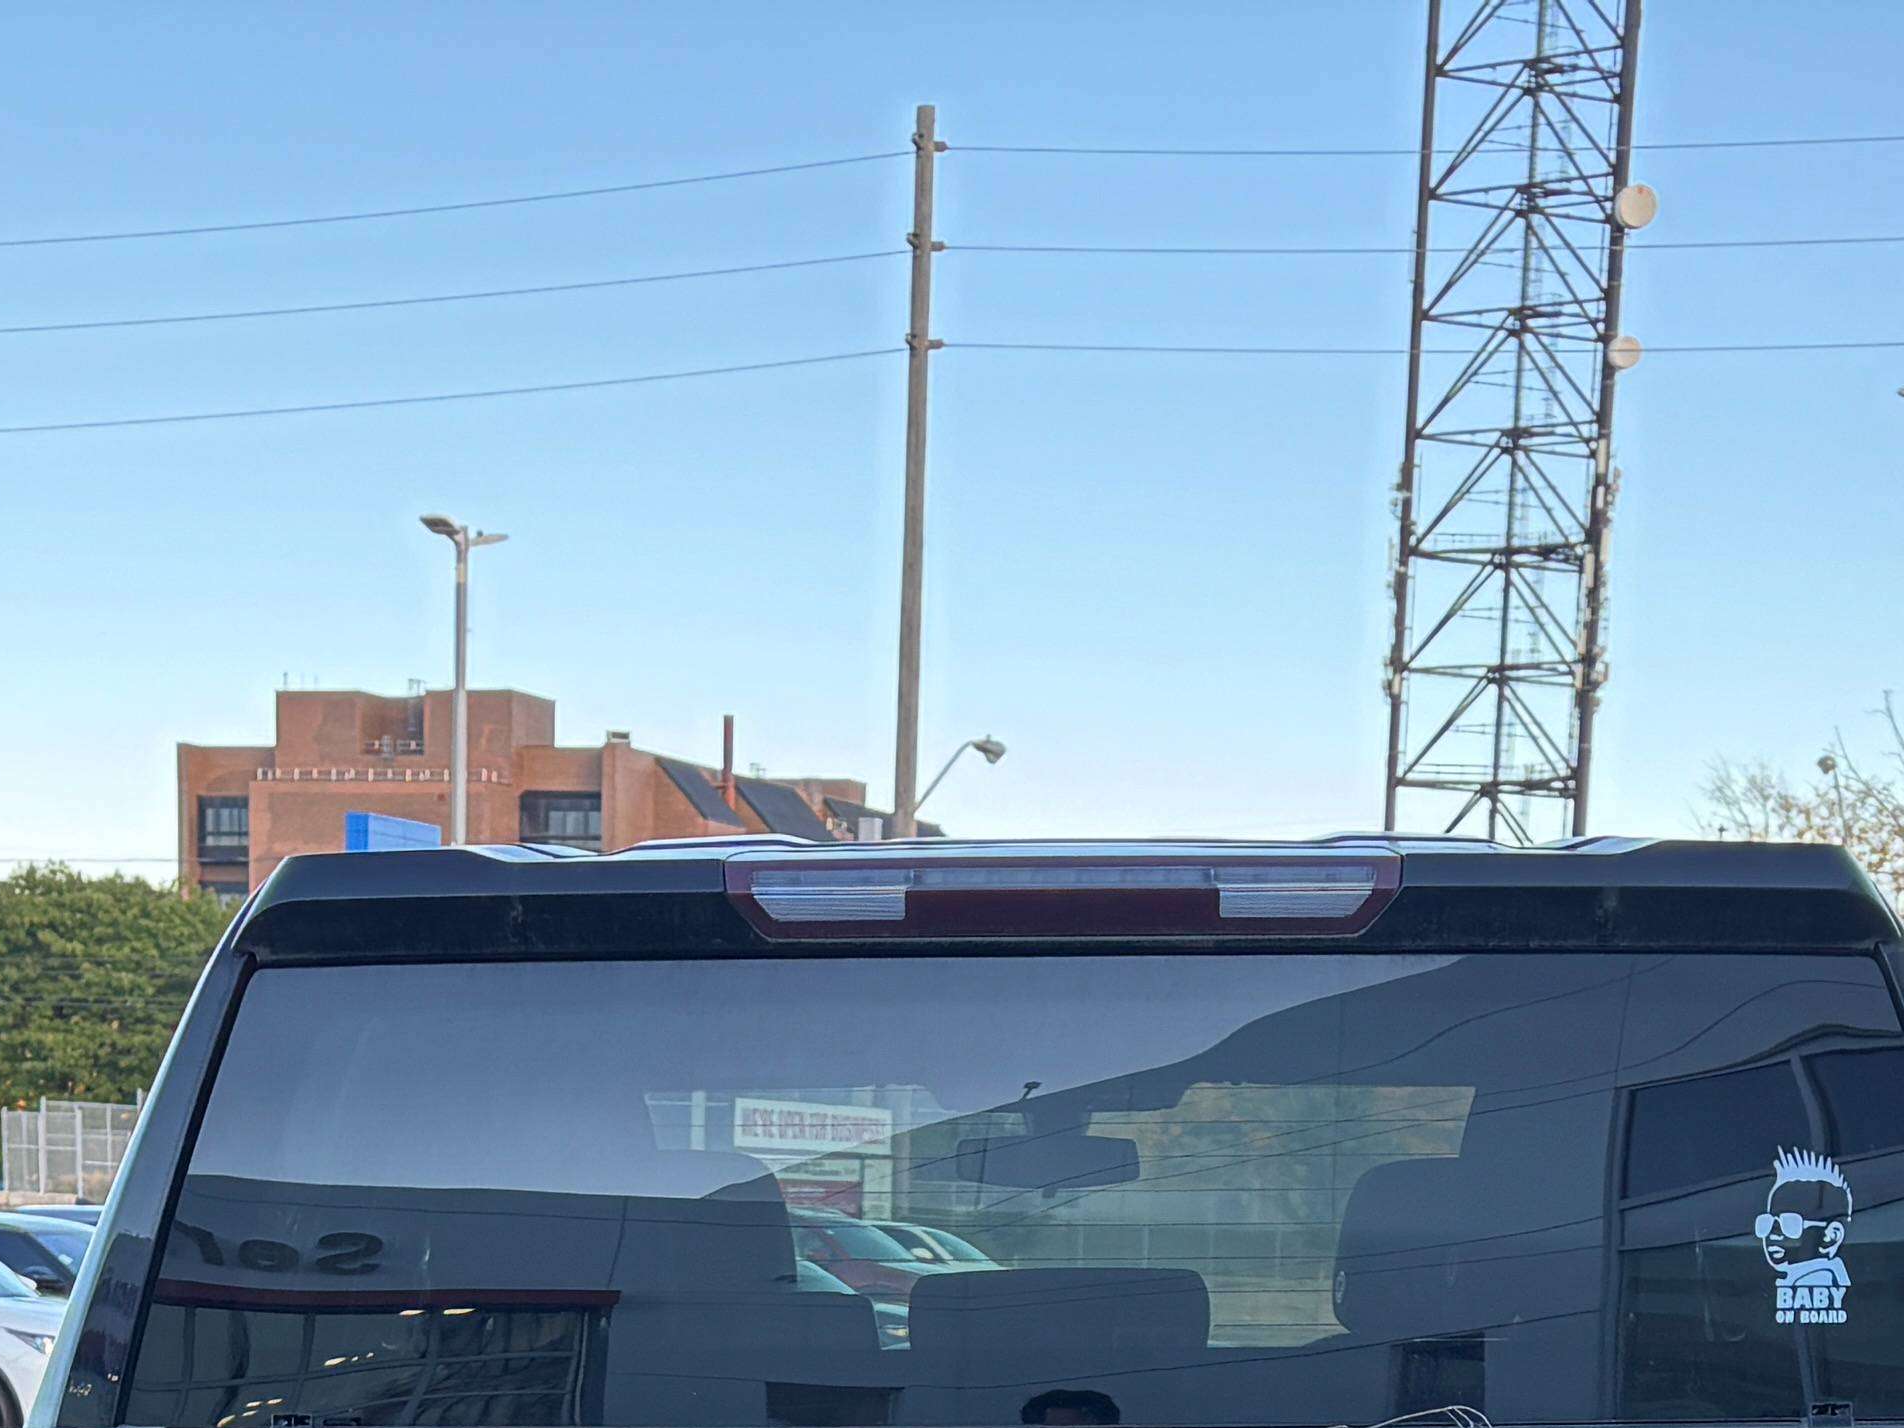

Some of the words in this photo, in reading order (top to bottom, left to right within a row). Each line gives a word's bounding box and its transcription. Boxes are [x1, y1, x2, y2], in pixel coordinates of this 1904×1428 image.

[1776, 1287, 1847, 1309] BABY
[1775, 1310, 1794, 1324] ON
[1800, 1310, 1847, 1324] BOARD
